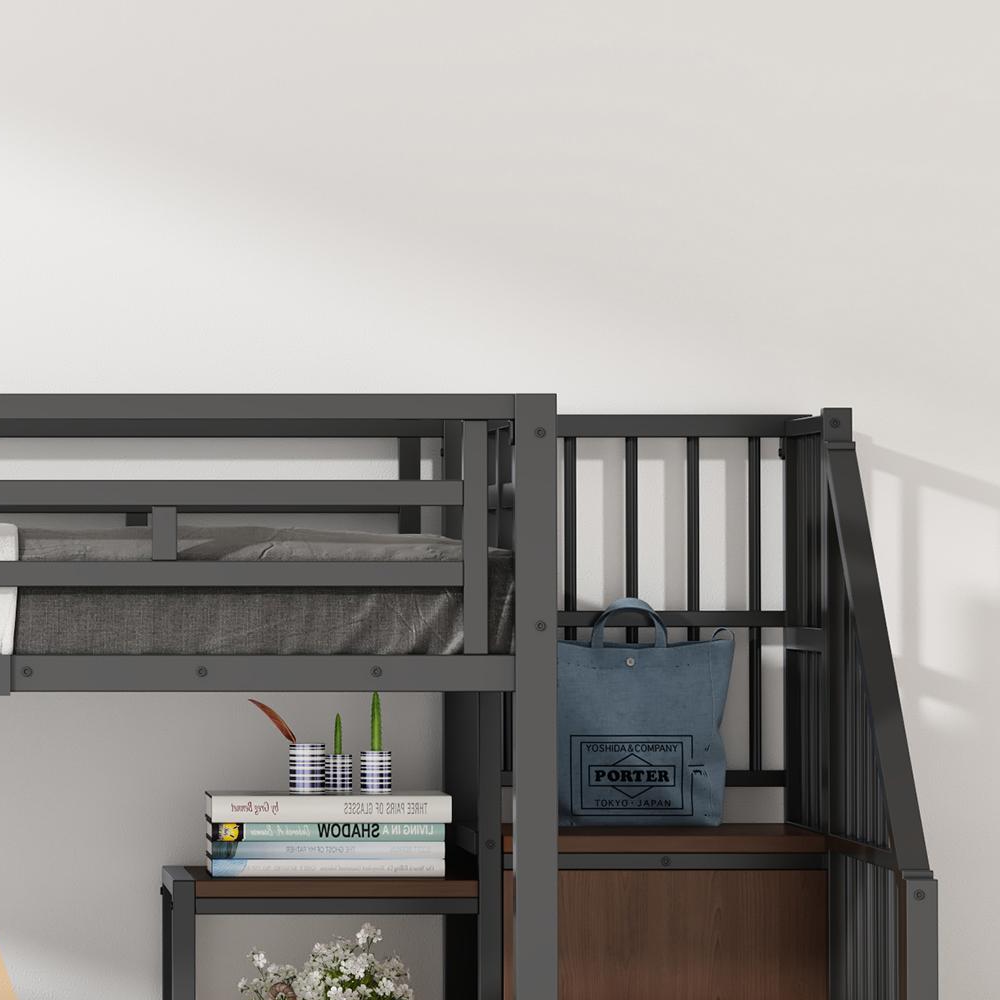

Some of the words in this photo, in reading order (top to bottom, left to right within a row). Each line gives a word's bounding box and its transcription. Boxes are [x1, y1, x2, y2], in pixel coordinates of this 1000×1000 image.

[594, 769, 670, 783] PORTER
[595, 799, 628, 808] TOKYO
[637, 799, 672, 808] JAPAN
